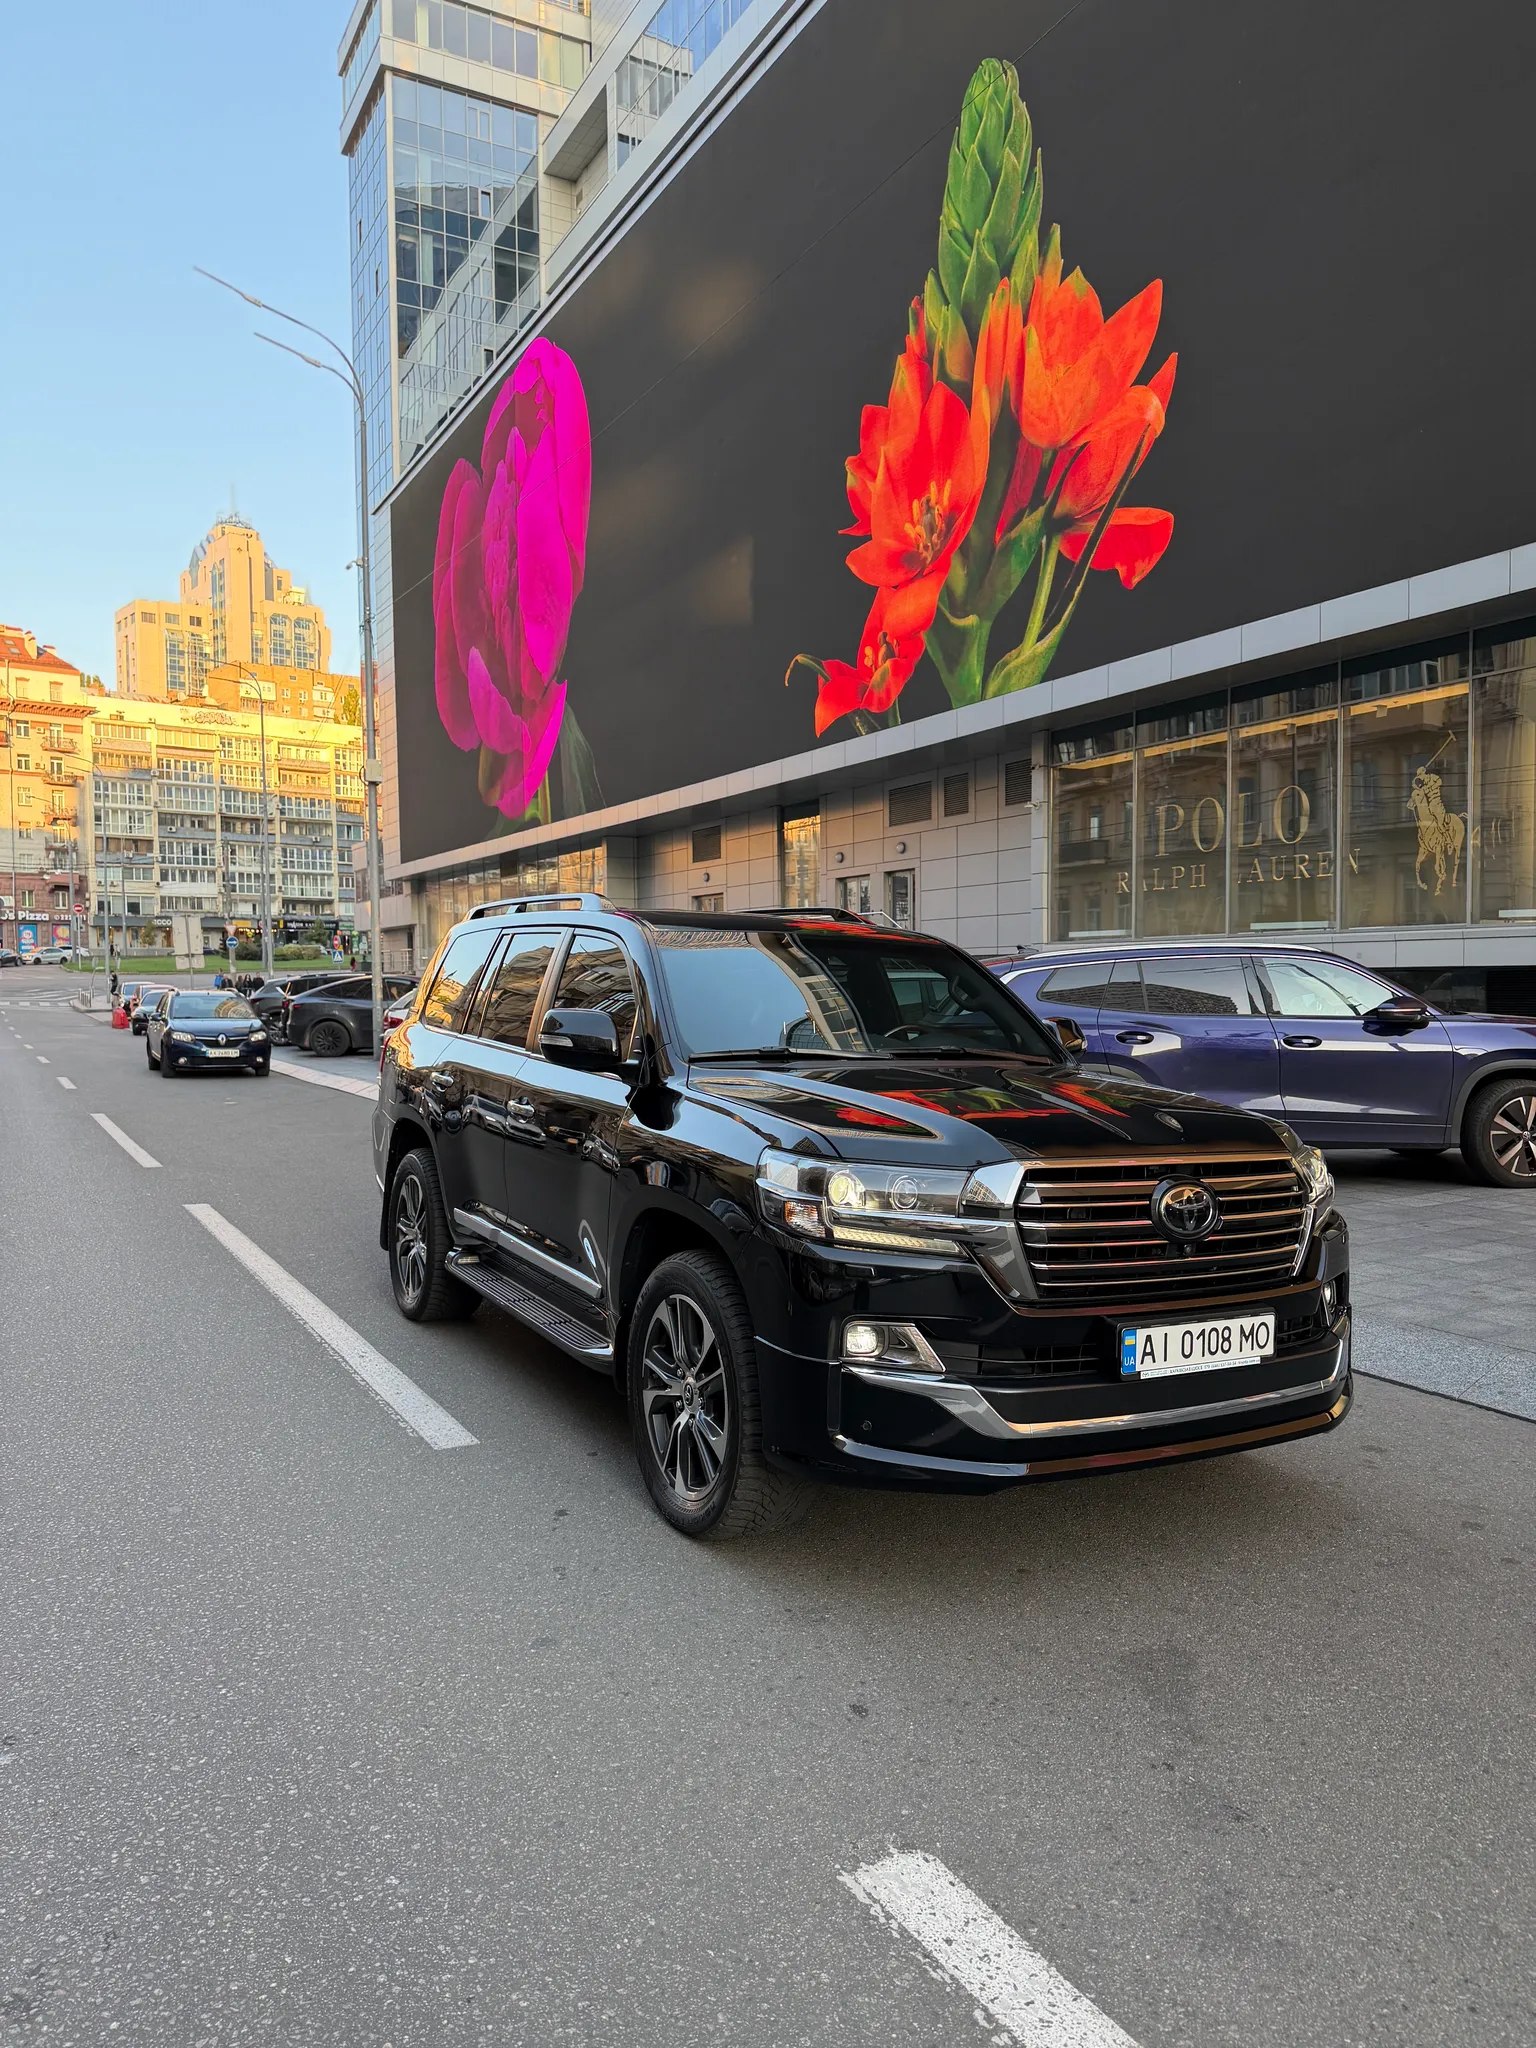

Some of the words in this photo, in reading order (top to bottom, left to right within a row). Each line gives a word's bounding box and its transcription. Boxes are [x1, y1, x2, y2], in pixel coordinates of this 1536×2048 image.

[1154, 785, 1310, 857] POLO
[1116, 864, 1206, 894] RLPH
[1237, 848, 1361, 884] AUREN
[17, 910, 50, 921] Pizza
[1124, 1357, 1136, 1366] UA
[1140, 1333, 1168, 1365] AI
[1181, 1325, 1232, 1359] 0108
[1239, 1321, 1270, 1353] MO
